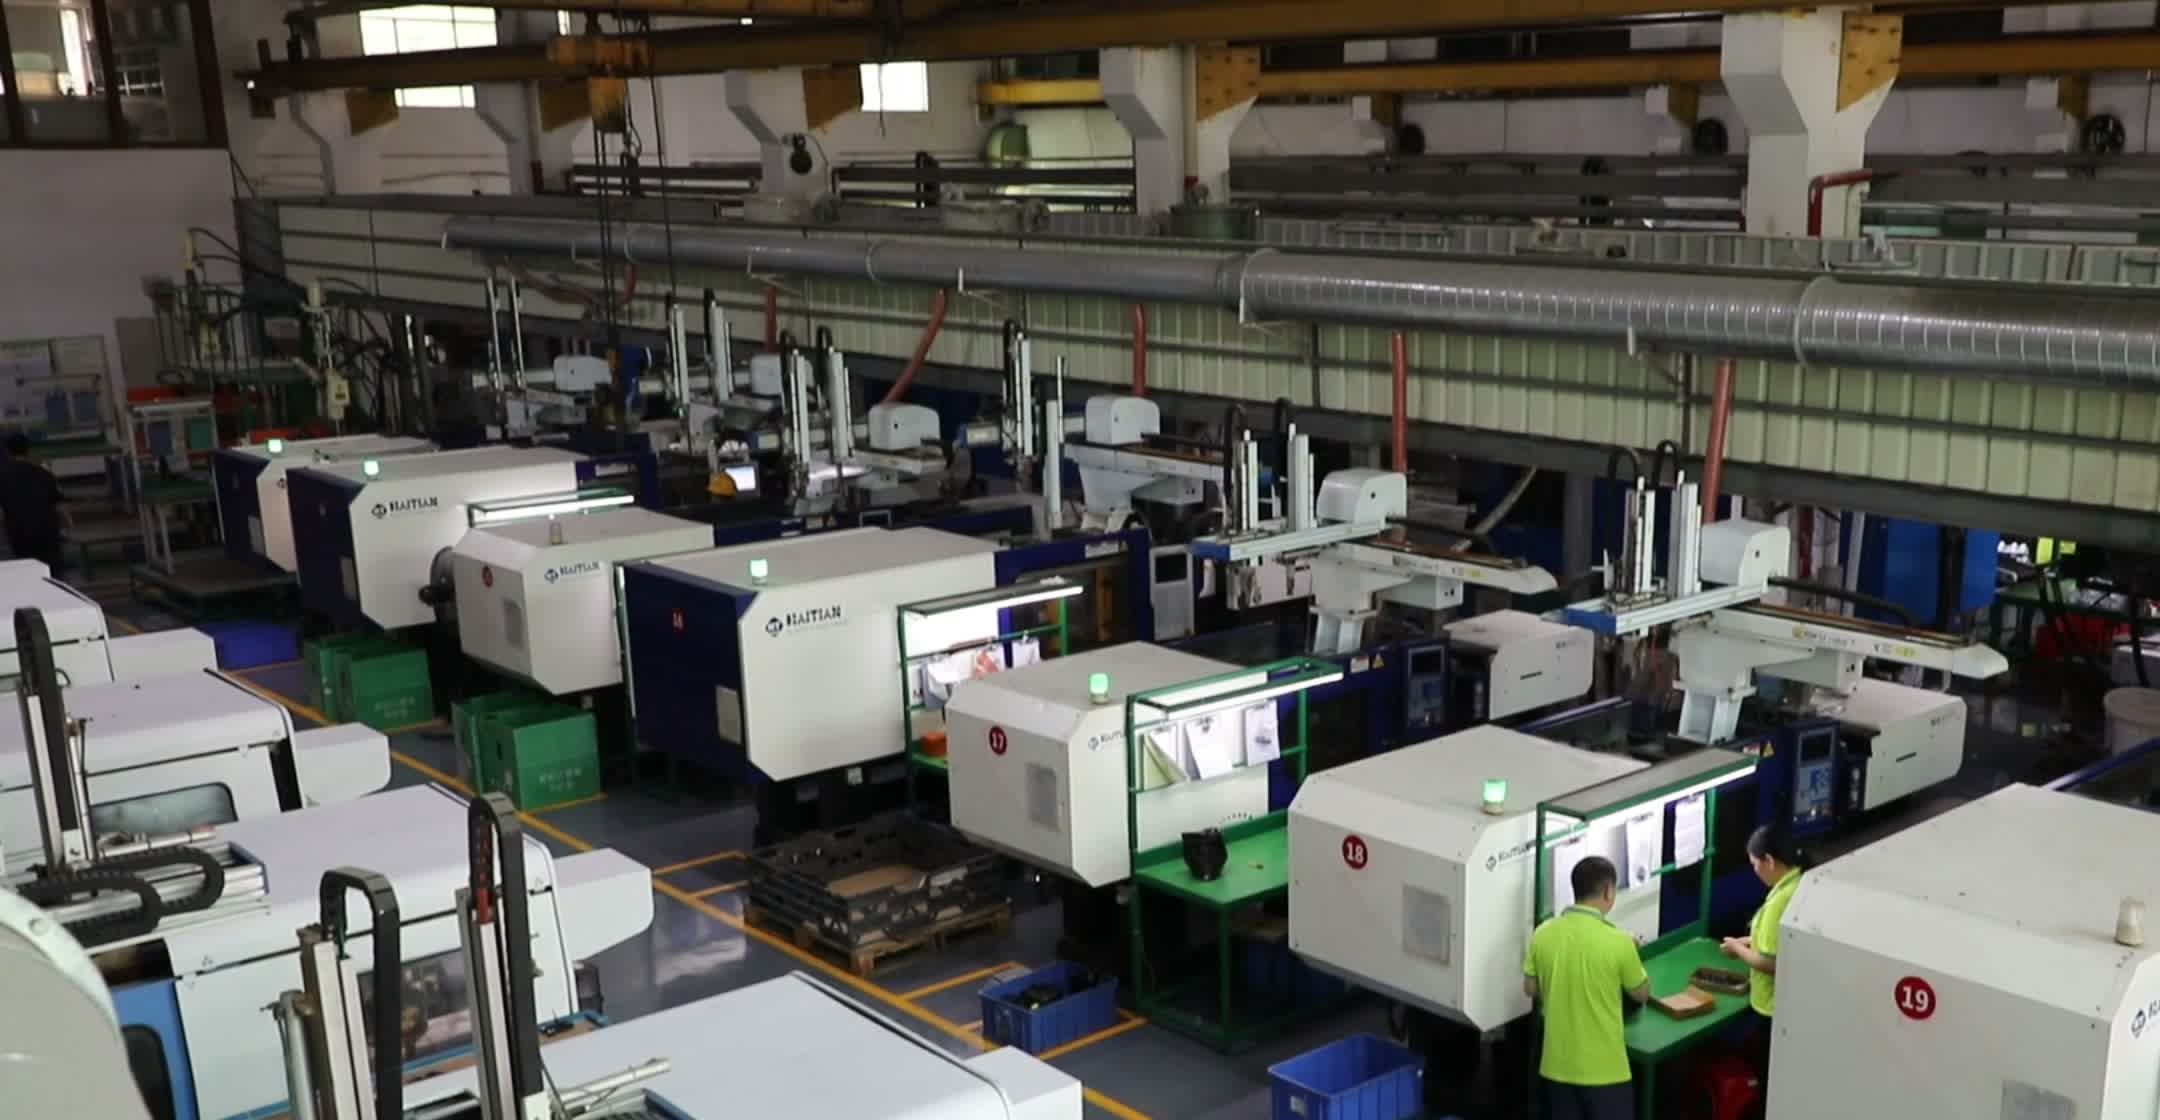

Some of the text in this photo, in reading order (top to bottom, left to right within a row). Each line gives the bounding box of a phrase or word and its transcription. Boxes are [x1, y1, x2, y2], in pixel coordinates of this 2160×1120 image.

[786, 604, 841, 627] HAITIAN
[993, 732, 1004, 750] 17
[1347, 842, 1364, 863] 18
[1902, 985, 1929, 1012] 19
